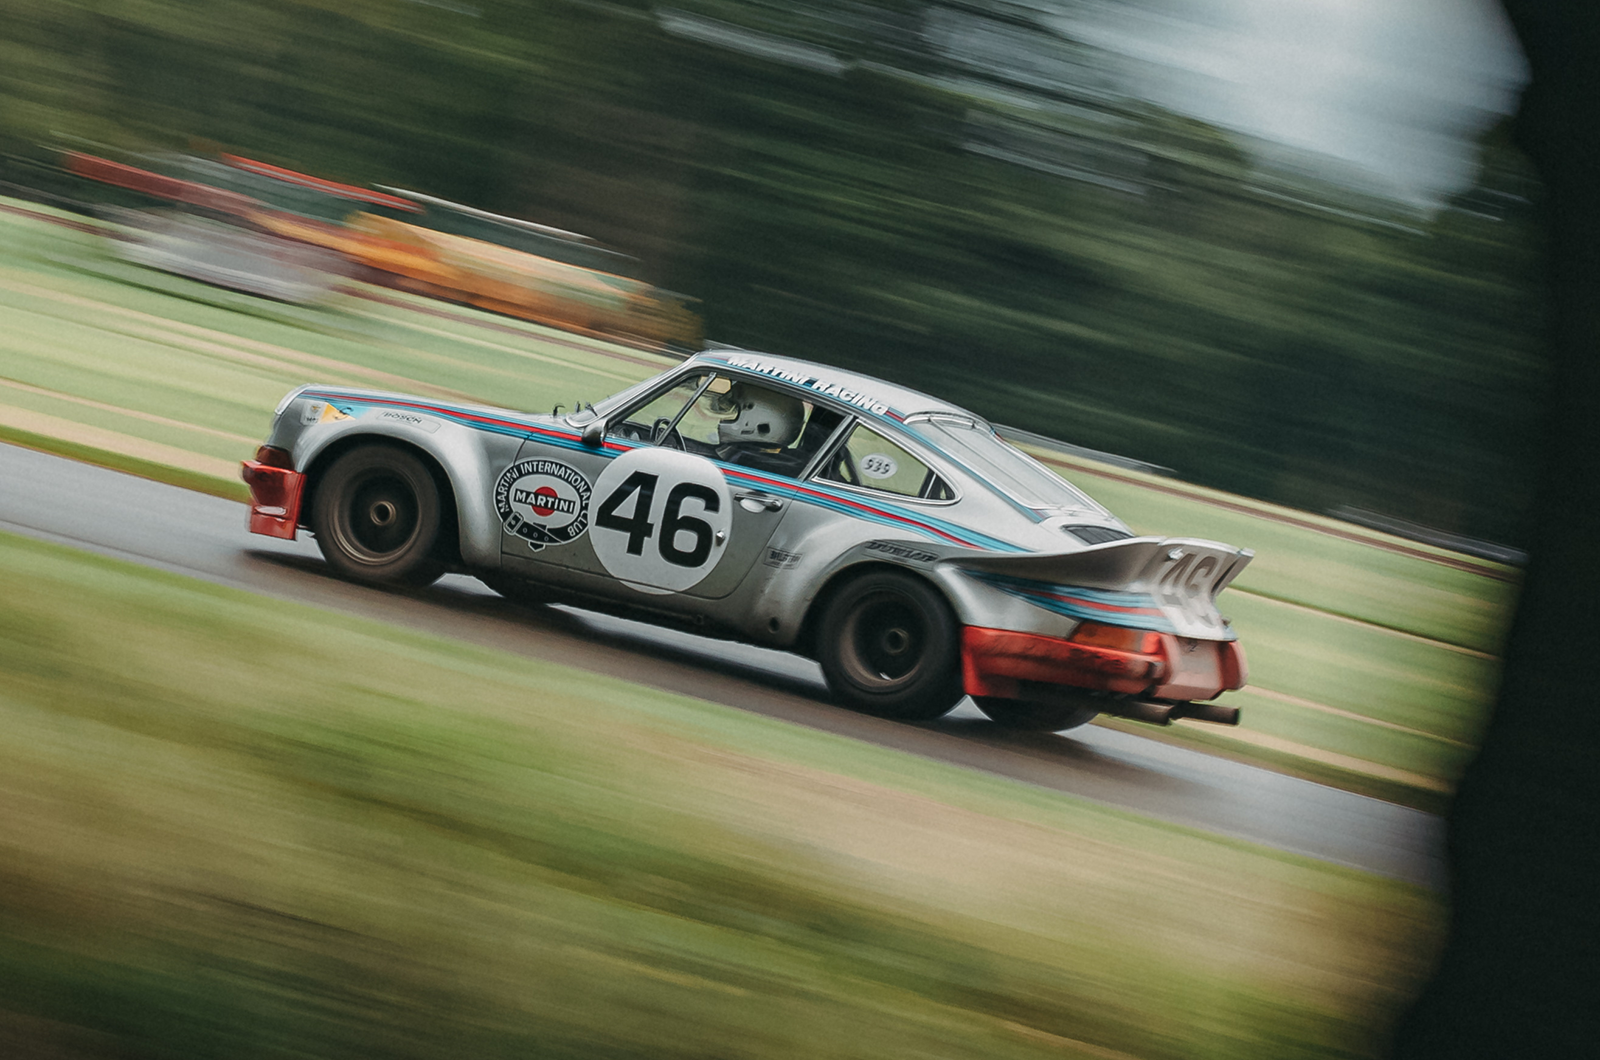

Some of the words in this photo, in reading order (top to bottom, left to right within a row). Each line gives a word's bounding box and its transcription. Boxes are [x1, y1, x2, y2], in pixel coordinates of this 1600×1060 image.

[727, 356, 811, 386] MARTINI
[811, 378, 889, 416] RACING
[864, 457, 890, 475] 939
[497, 467, 519, 513] MARTINI
[520, 461, 591, 507] INTERNATIONAL
[567, 510, 588, 537] CLUB
[515, 490, 574, 513] MARTINI
[595, 470, 720, 568] 46
